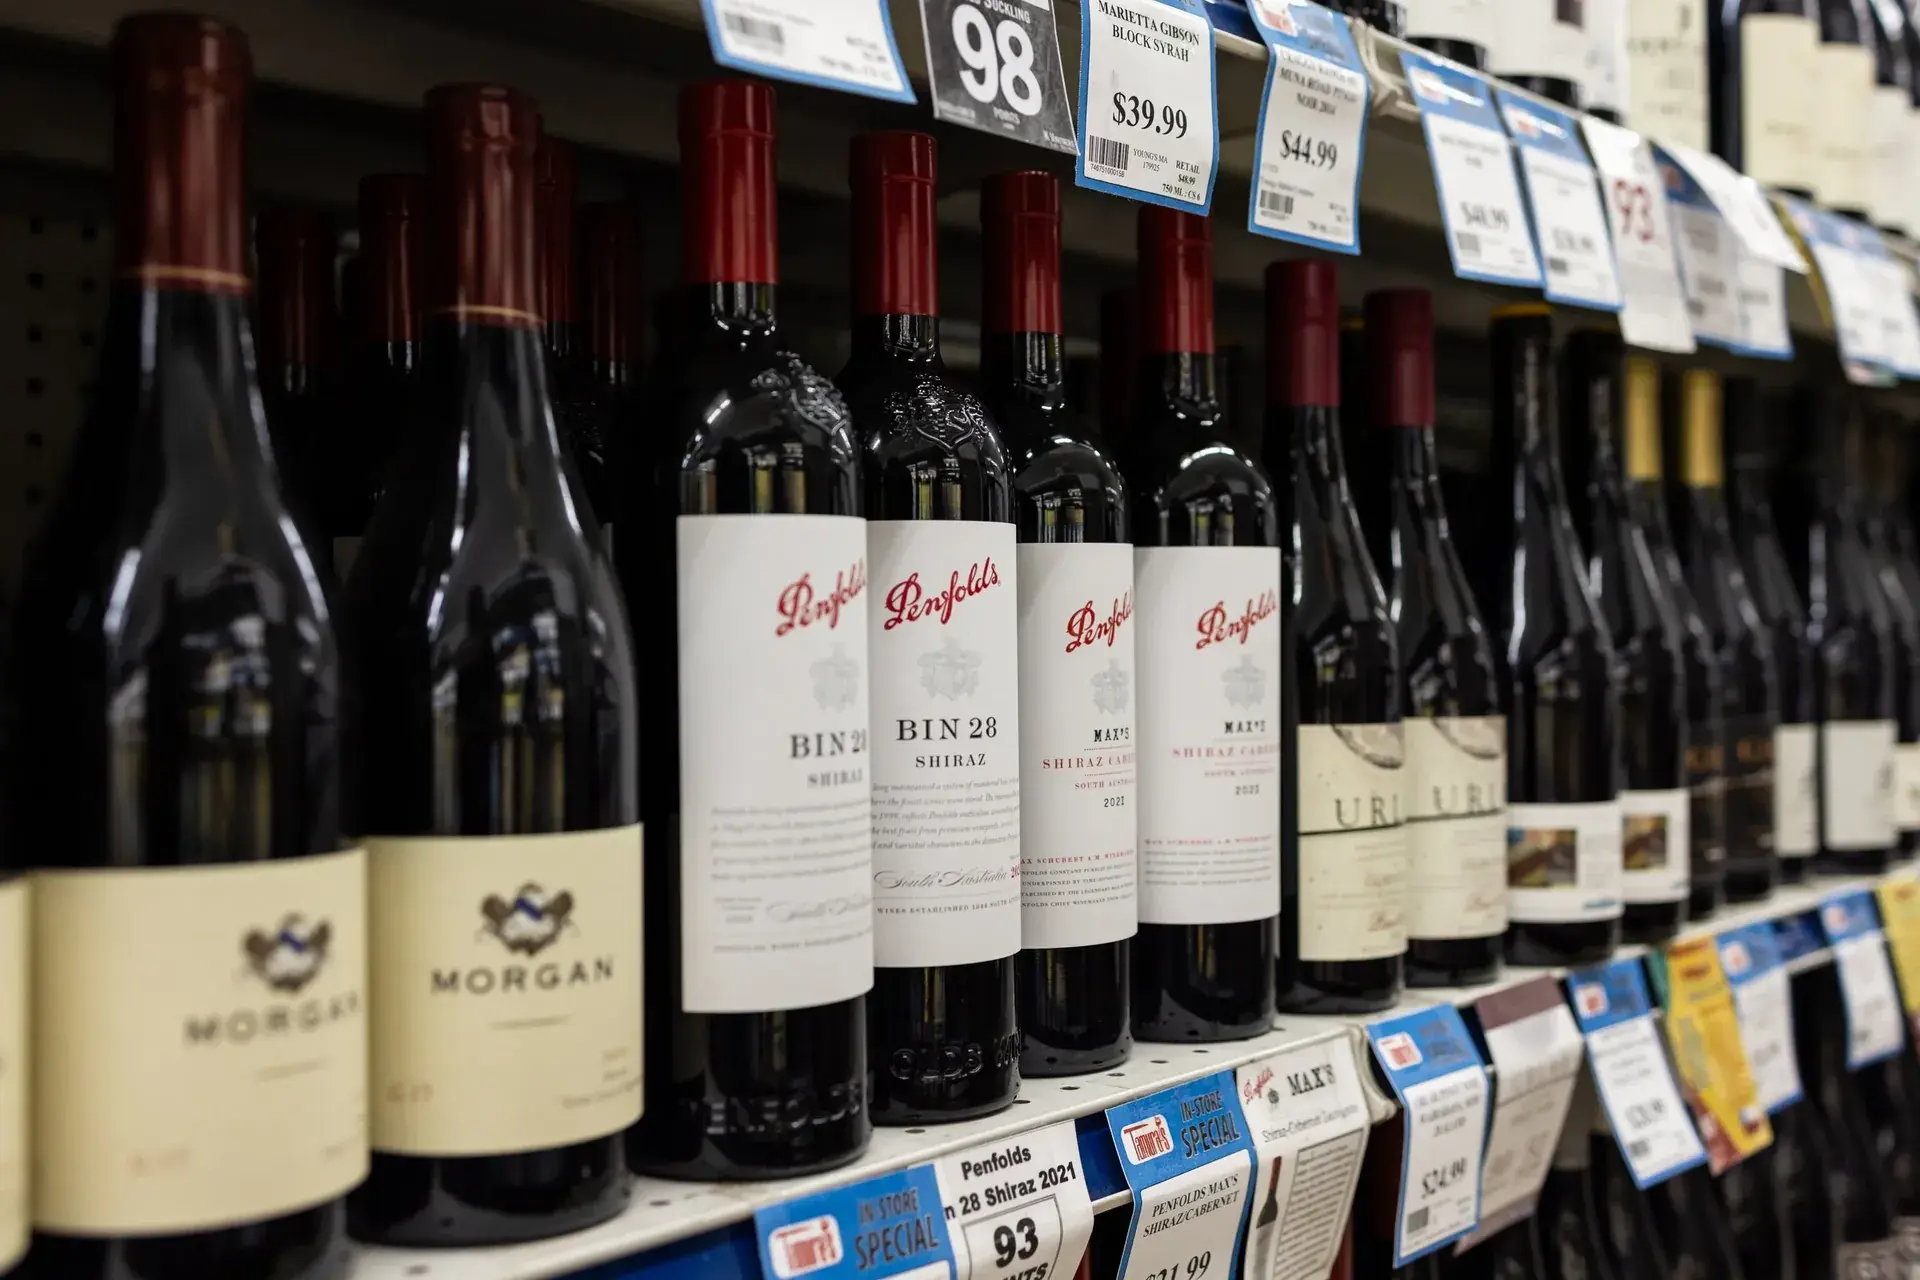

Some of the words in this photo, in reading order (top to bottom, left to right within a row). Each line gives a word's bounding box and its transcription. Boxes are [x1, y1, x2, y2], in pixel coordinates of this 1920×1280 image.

[1098, 0, 1158, 32] MARIETTA
[1160, 21, 1199, 45] GIBSON
[952, 4, 1042, 116] 98
[1112, 24, 1151, 50] BLOCK
[1153, 38, 1189, 62] SYRAH
[1112, 92, 1187, 138] $39.99
[1175, 160, 1200, 174] RETAIL
[1280, 129, 1337, 170] $44.99
[1162, 184, 1173, 193] 750
[1613, 177, 1655, 245] 93
[884, 556, 1000, 631] Penfolds
[1065, 588, 1132, 653] Penfold
[1196, 588, 1276, 650] Penfolds
[790, 731, 845, 759] BIN
[896, 719, 960, 741] BIN
[969, 717, 997, 739] 28
[1094, 727, 1130, 742] MAX'S
[915, 753, 986, 768] SHIRAZ
[1042, 756, 1103, 770] SHIRAZ
[1171, 746, 1234, 758] SHIRAZ
[1074, 781, 1104, 790] SOUTH
[430, 955, 614, 995] MORGAN
[1286, 1063, 1336, 1096] MAX'S
[1180, 1091, 1223, 1123] IN-STORE
[1180, 1111, 1240, 1159] SPECIAL
[961, 1146, 1031, 1180] Penfolds
[959, 1192, 981, 1215] 28
[984, 1178, 1037, 1207] Shiraz
[1038, 1161, 1077, 1190] 2021
[1152, 1187, 1206, 1218] PENFOLDS
[1143, 1190, 1240, 1238] SHIRAZ/CABERNET
[855, 1214, 940, 1270] SPECIAL
[993, 1217, 1038, 1269] 93
